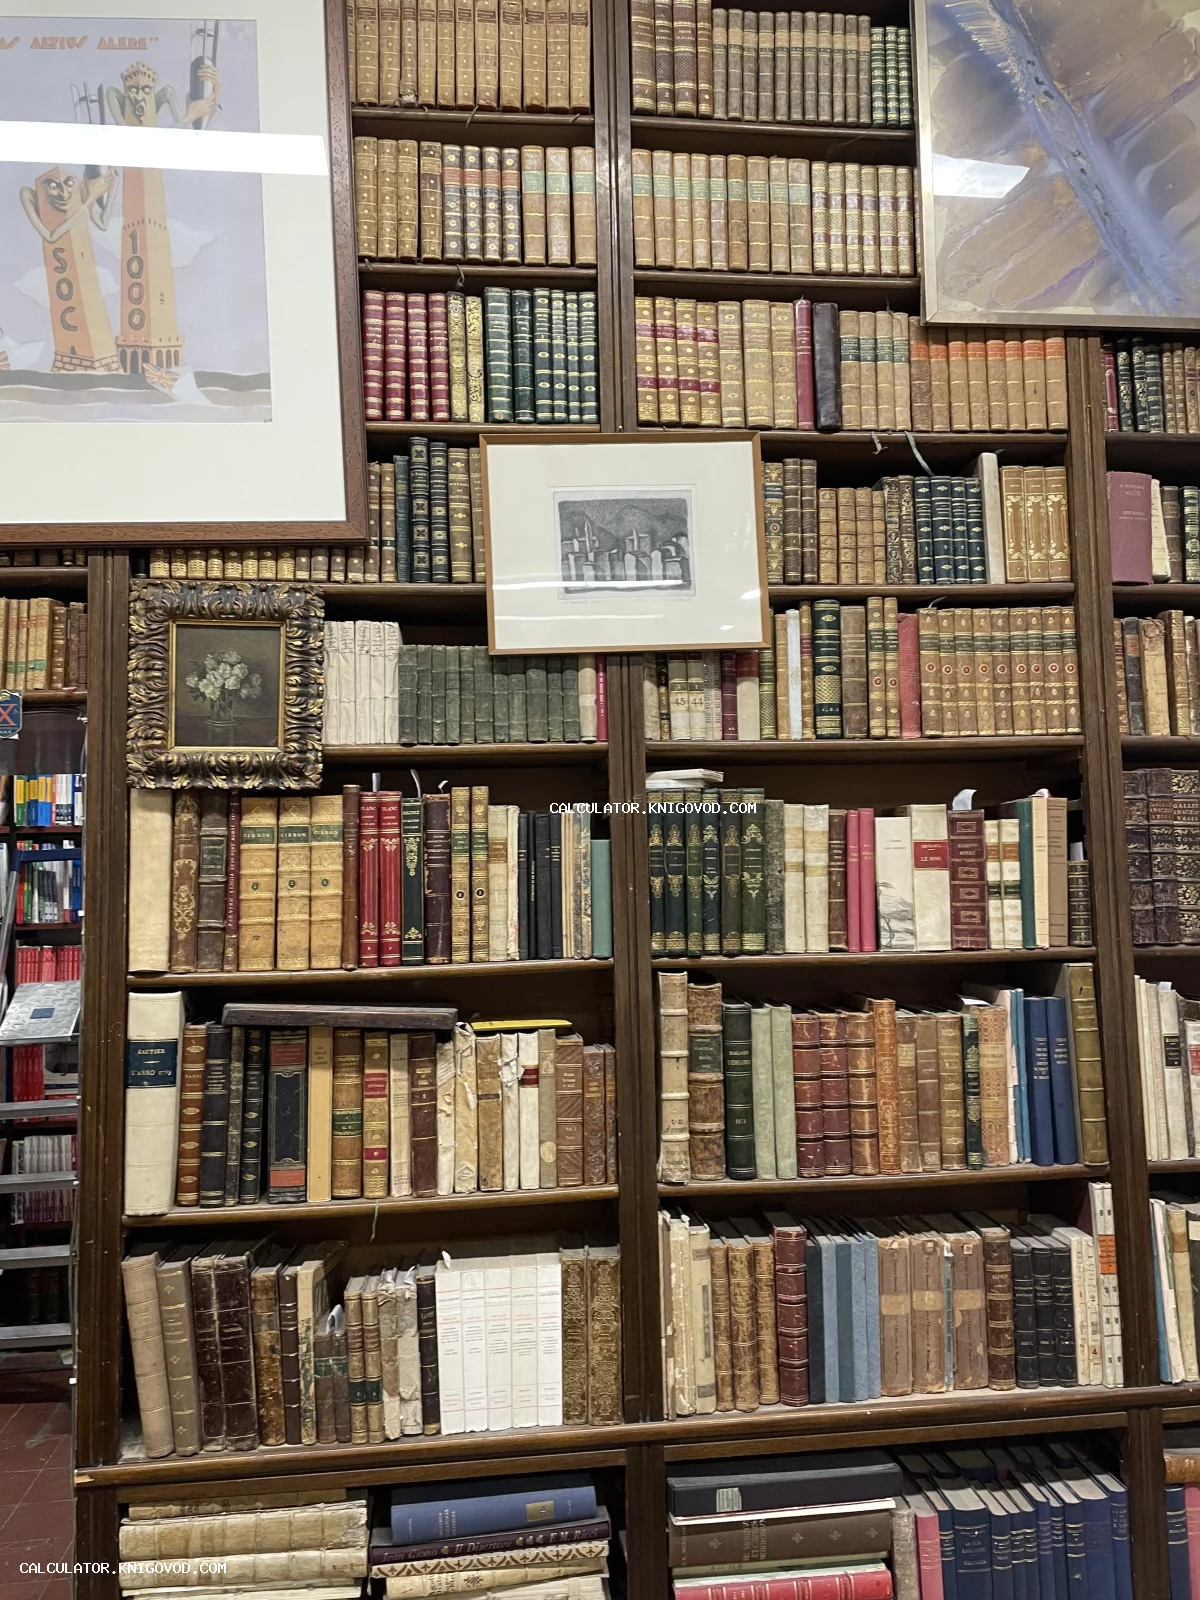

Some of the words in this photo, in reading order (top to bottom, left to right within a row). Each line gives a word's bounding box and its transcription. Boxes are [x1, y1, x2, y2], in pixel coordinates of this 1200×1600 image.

[126, 229, 146, 331] 1000
[52, 247, 78, 332] SOC
[674, 698, 686, 706] 45
[691, 698, 704, 706] 44
[574, 1528, 599, 1540] Ricci
